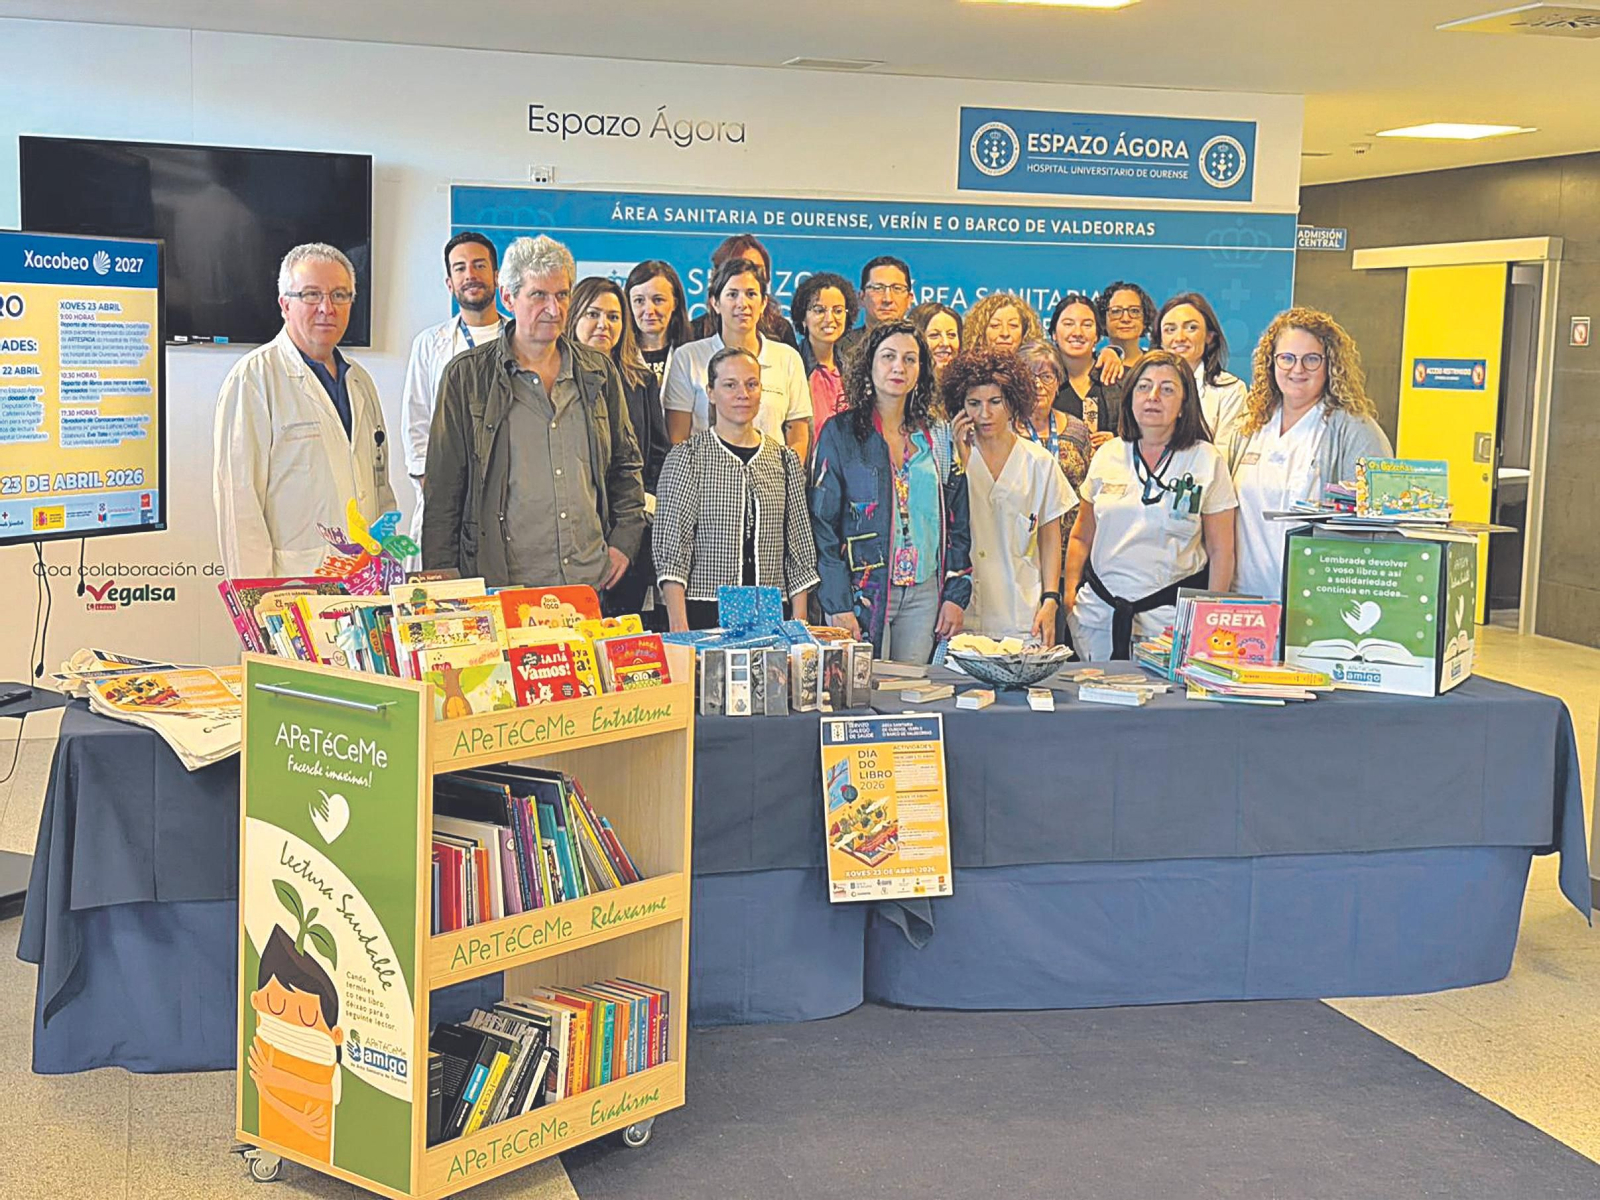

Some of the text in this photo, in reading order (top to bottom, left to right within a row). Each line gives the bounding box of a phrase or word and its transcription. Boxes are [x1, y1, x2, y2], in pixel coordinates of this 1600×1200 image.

[527, 104, 746, 148] Espazo Ágora
[1027, 133, 1108, 156] ESPAZO
[1113, 131, 1190, 160] ÁGORA
[1027, 163, 1189, 179] HOSPITAL UNIVERSITARIO DE OURENSE
[611, 201, 1156, 236] ÁREA SANITARIA DE OURENSE, VERÍN E O BARCO DE VALDEORRAS
[1298, 229, 1342, 239] ADMISIÓN
[1298, 238, 1340, 247] CENTRAL
[24, 249, 144, 274] Xacobeo 2027
[60, 302, 121, 312] XOVES 23 ABRIL
[2, 366, 40, 375] 22 ABRIL
[1, 469, 144, 494] 23 DE ABRIL 2026
[1319, 555, 1408, 568] Lembrade devolver
[32, 561, 225, 577] Coa colaboración de
[1356, 567, 1378, 576] libro
[1335, 576, 1398, 587] solidariedade
[86, 580, 176, 606] Vegalsa
[1316, 585, 1357, 595] continúa
[1206, 612, 1266, 627] GRETA
[516, 662, 571, 681] Vamos!
[1347, 672, 1380, 682] amigo
[453, 703, 673, 757] APeTéCeMe Entreterme
[275, 722, 388, 769] APeTéCeMe
[858, 748, 877, 759] DÍA
[859, 760, 876, 769] DO
[859, 770, 893, 779] LIBRO
[860, 780, 885, 790] 2026
[280, 840, 396, 992] Lectura Saudable
[450, 897, 667, 970] APeTéCeMe Relaxarme
[346, 971, 367, 983] Cando
[346, 981, 375, 995] termines
[355, 994, 366, 1002] teu
[345, 1010, 373, 1023] seguinte
[369, 1008, 384, 1017] para
[364, 1049, 407, 1076] amigo
[447, 1088, 661, 1183] APeTéCeMe Evadirme
